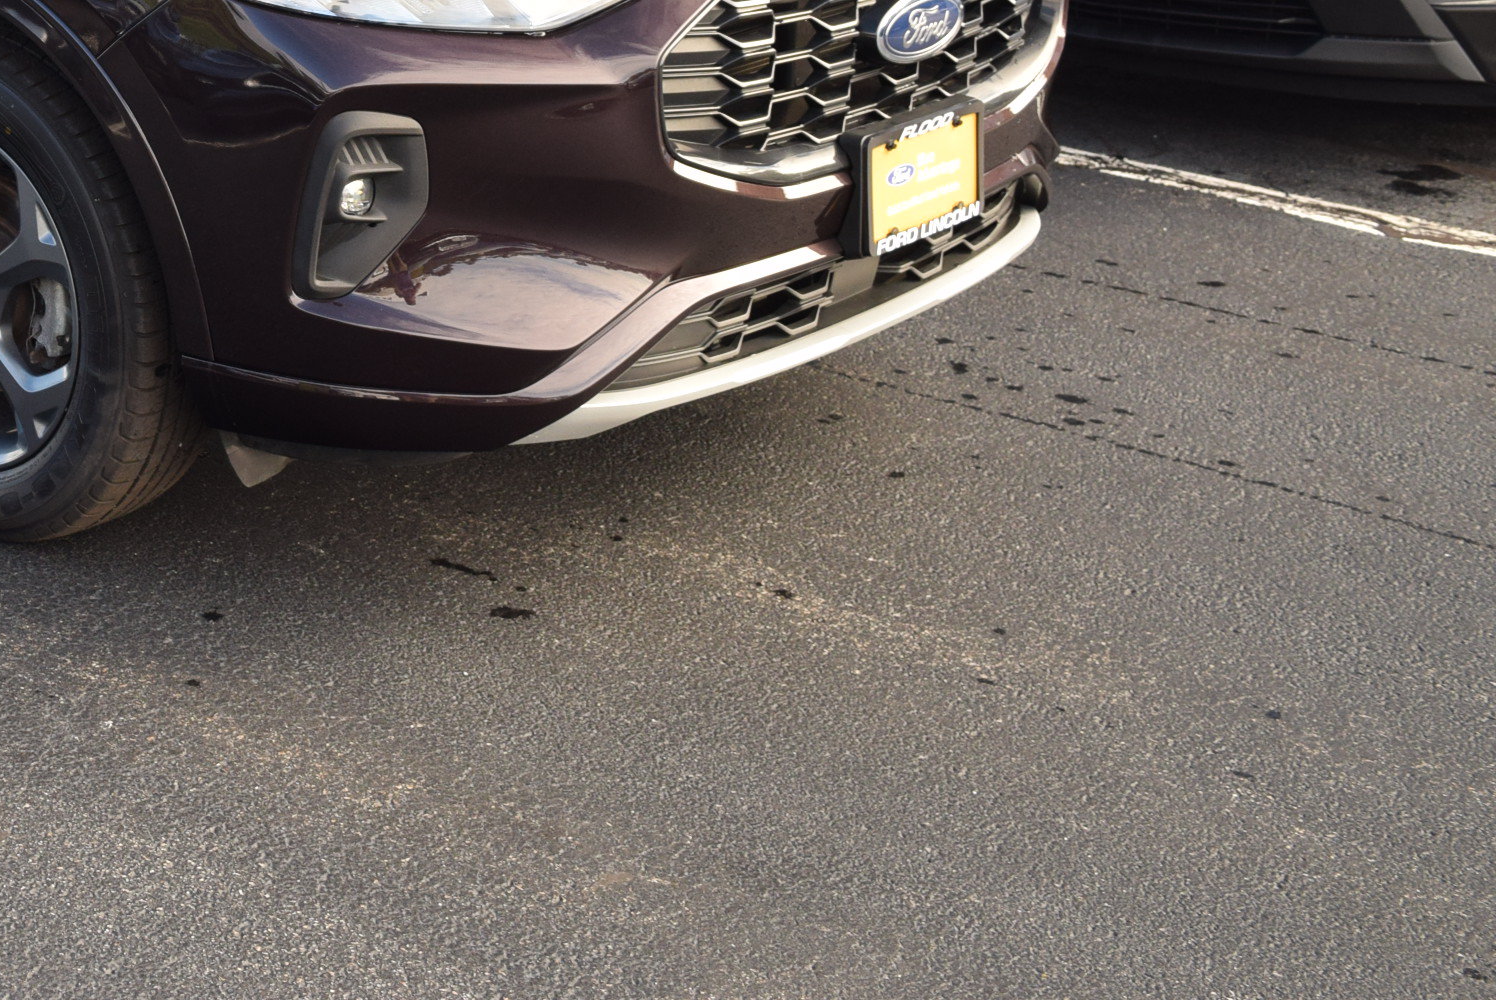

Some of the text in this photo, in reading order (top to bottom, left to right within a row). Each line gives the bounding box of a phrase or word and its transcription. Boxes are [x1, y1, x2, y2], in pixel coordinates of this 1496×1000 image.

[902, 4, 951, 49] Ford
[898, 111, 954, 142] FLOOD
[876, 200, 980, 256] FORD LINCOLN
